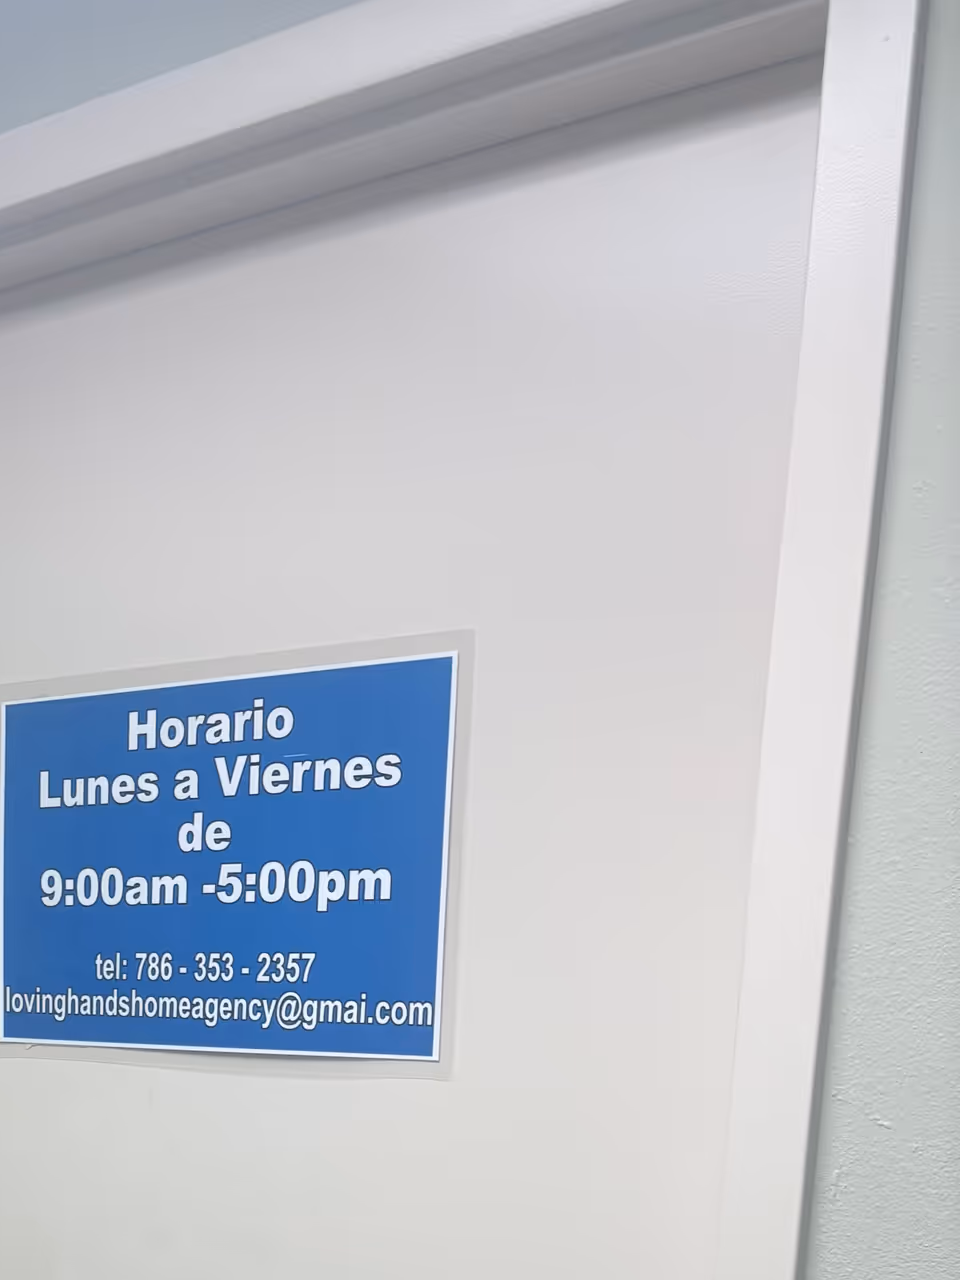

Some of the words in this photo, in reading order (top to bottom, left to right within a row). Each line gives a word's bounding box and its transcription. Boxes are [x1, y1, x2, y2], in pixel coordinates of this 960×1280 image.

[127, 698, 295, 751] Horario
[39, 770, 160, 808] Lunes
[173, 769, 199, 800] a
[214, 753, 403, 798] Viernes
[177, 811, 232, 853] de
[40, 866, 188, 907] 9:00am
[201, 860, 393, 912] -5:00pm
[95, 952, 128, 981] tel:
[135, 952, 173, 981] 786
[193, 952, 234, 983] 353
[256, 952, 316, 983] 2357
[5, 986, 433, 1031] lovinghandshomeagency@gmai.com
